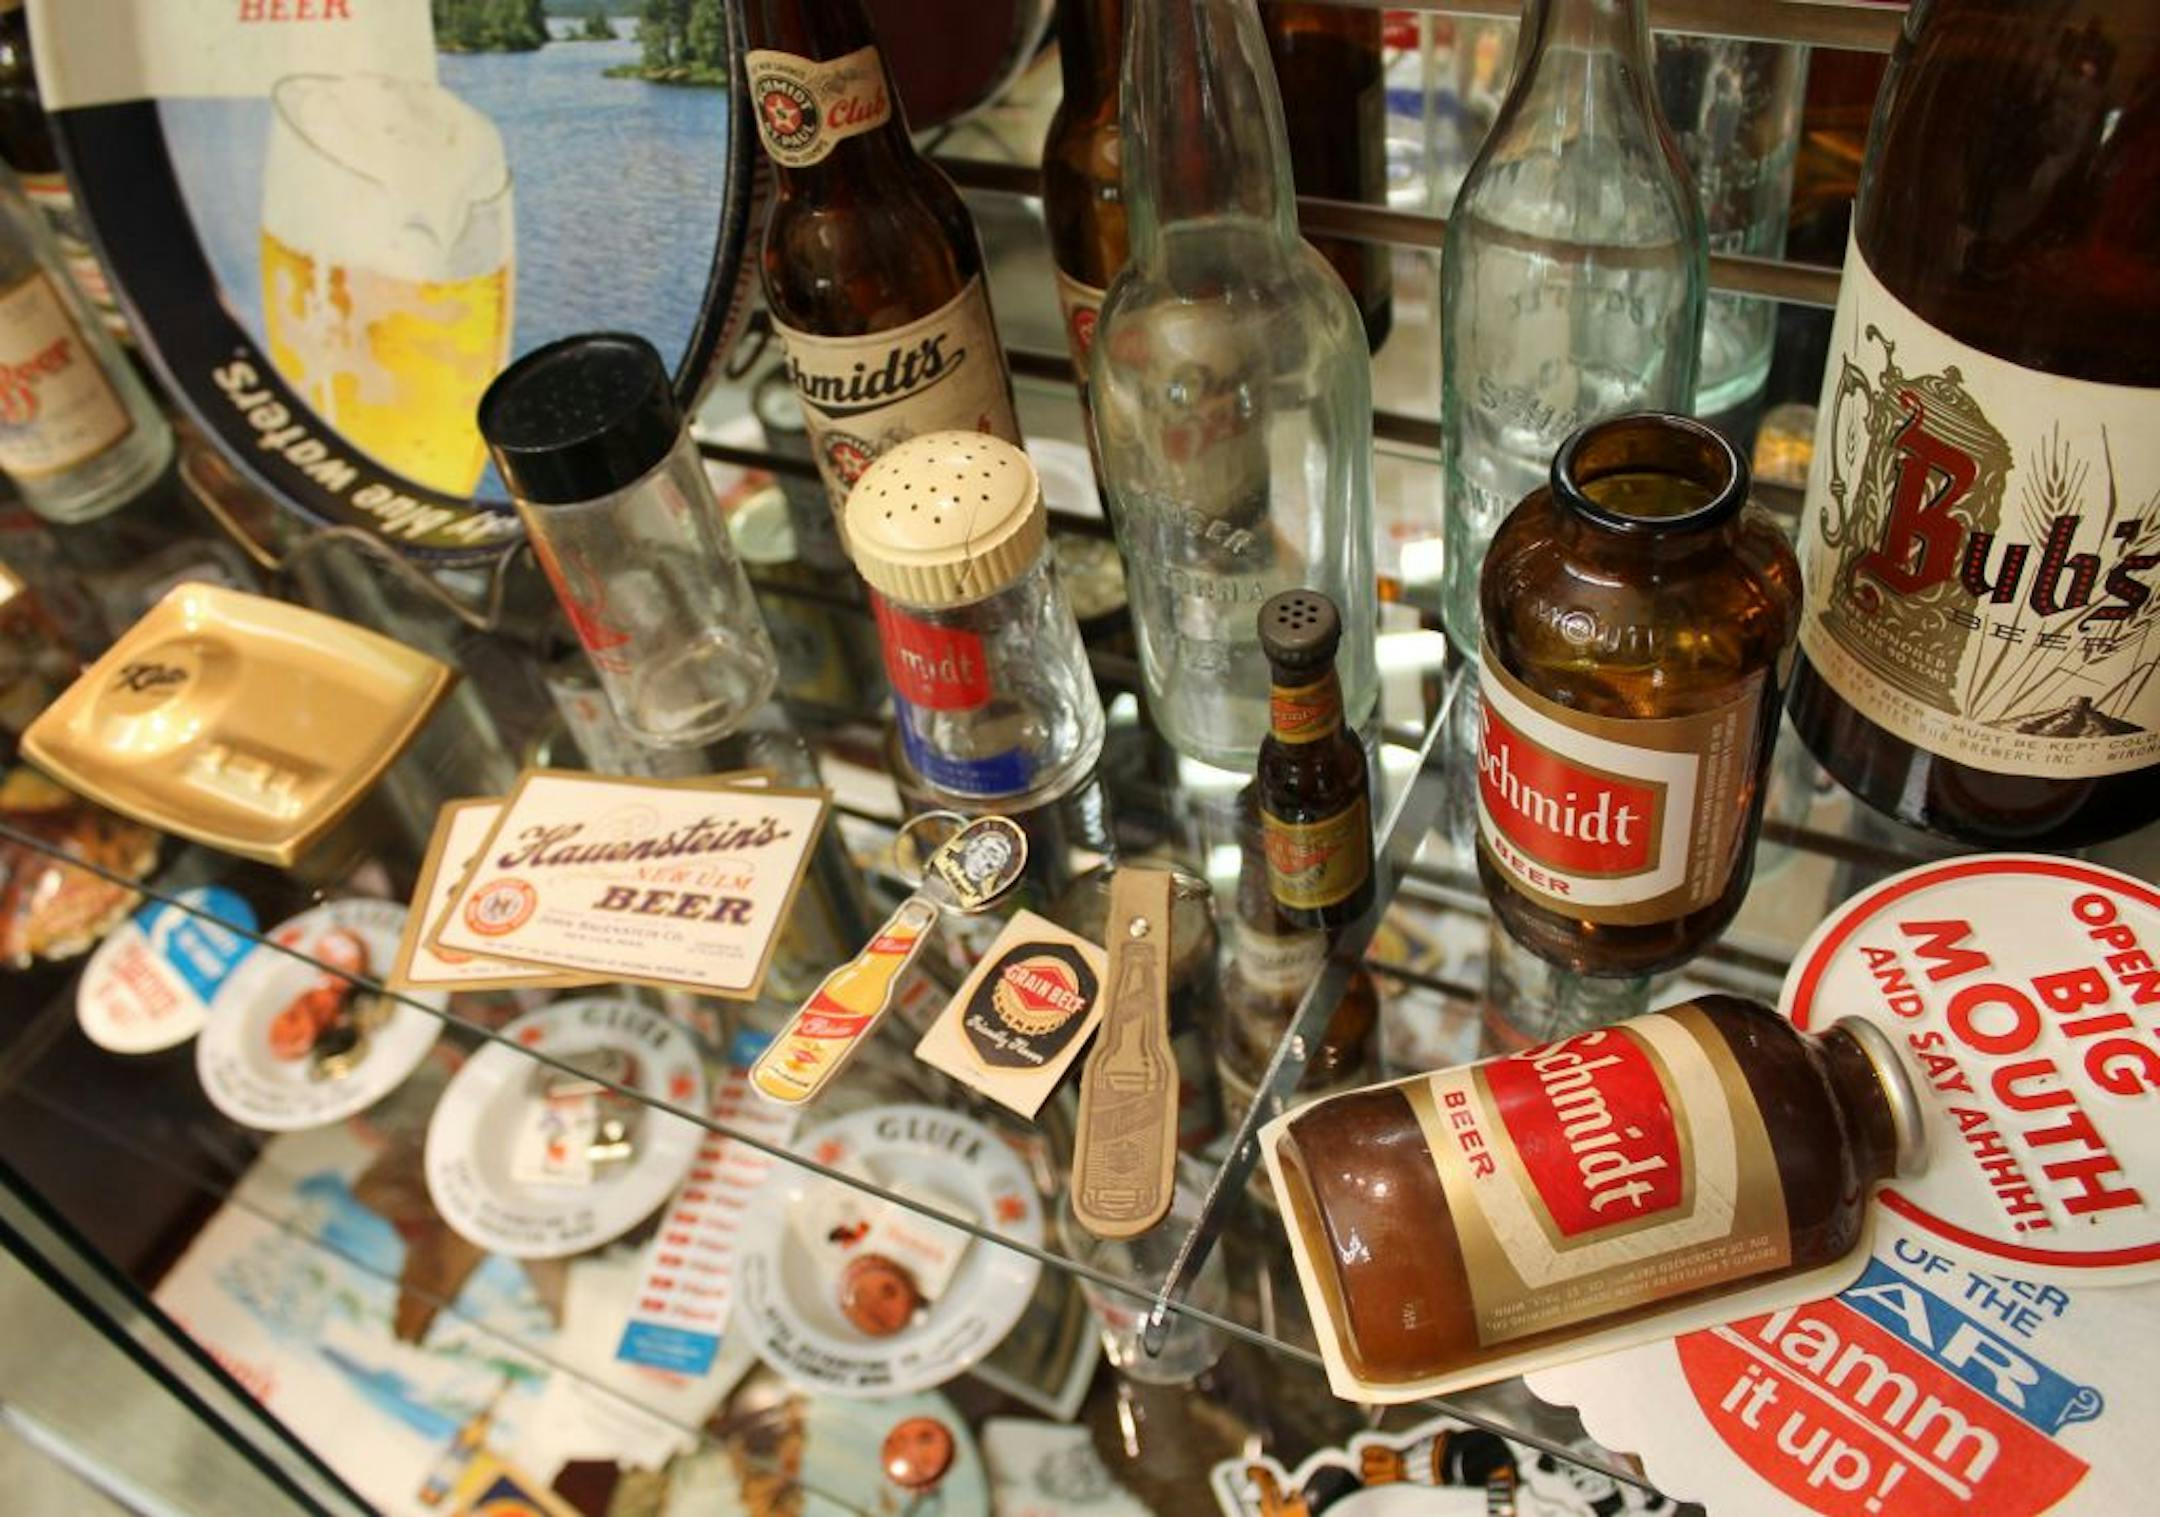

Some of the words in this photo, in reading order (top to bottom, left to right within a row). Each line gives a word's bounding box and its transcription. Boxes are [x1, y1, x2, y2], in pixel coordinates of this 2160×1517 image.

[351, 482, 454, 540] blue
[1478, 695, 1642, 848] Schmidt
[2049, 740, 2100, 754] KEPT
[497, 814, 793, 869] Hauenstein's
[1493, 835, 1572, 896] BEER
[591, 885, 755, 926] BEER
[2071, 892, 2160, 1006] OPEN
[1003, 963, 1050, 999] GRAIN
[1049, 973, 1087, 1016] BELT
[2030, 965, 2160, 1096] BIG
[1860, 946, 1924, 1019] AND
[1908, 1030, 1976, 1095] SAY
[1949, 1106, 2053, 1233] AHHH!
[1898, 919, 2145, 1216] MOUTH
[875, 1116, 983, 1163] GLUEK
[1444, 1089, 1498, 1181] BEER
[1508, 1029, 1669, 1214] Schmidt
[1894, 1238, 1957, 1274] OF
[1963, 1271, 2043, 1338] THE
[1845, 1281, 2041, 1420] AR
[1720, 1363, 1779, 1431] it
[1776, 1410, 1908, 1515] up!
